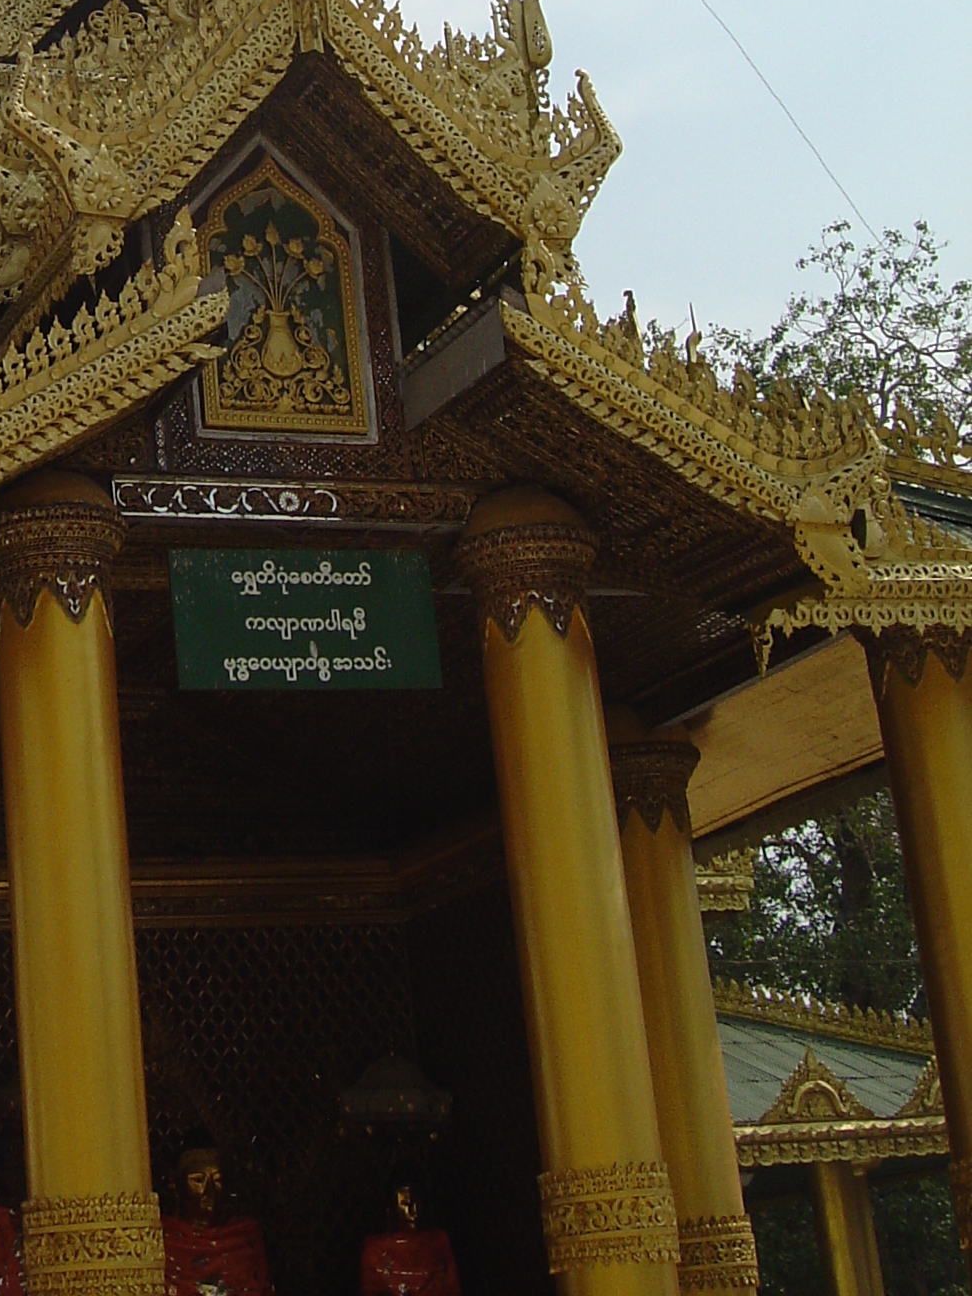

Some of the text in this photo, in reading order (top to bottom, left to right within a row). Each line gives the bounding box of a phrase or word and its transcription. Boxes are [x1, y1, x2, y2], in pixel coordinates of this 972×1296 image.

[231, 560, 372, 595] ရွှေတိဂုံစေတီတော်
[245, 607, 366, 640] ကလျာဏပါရမီ
